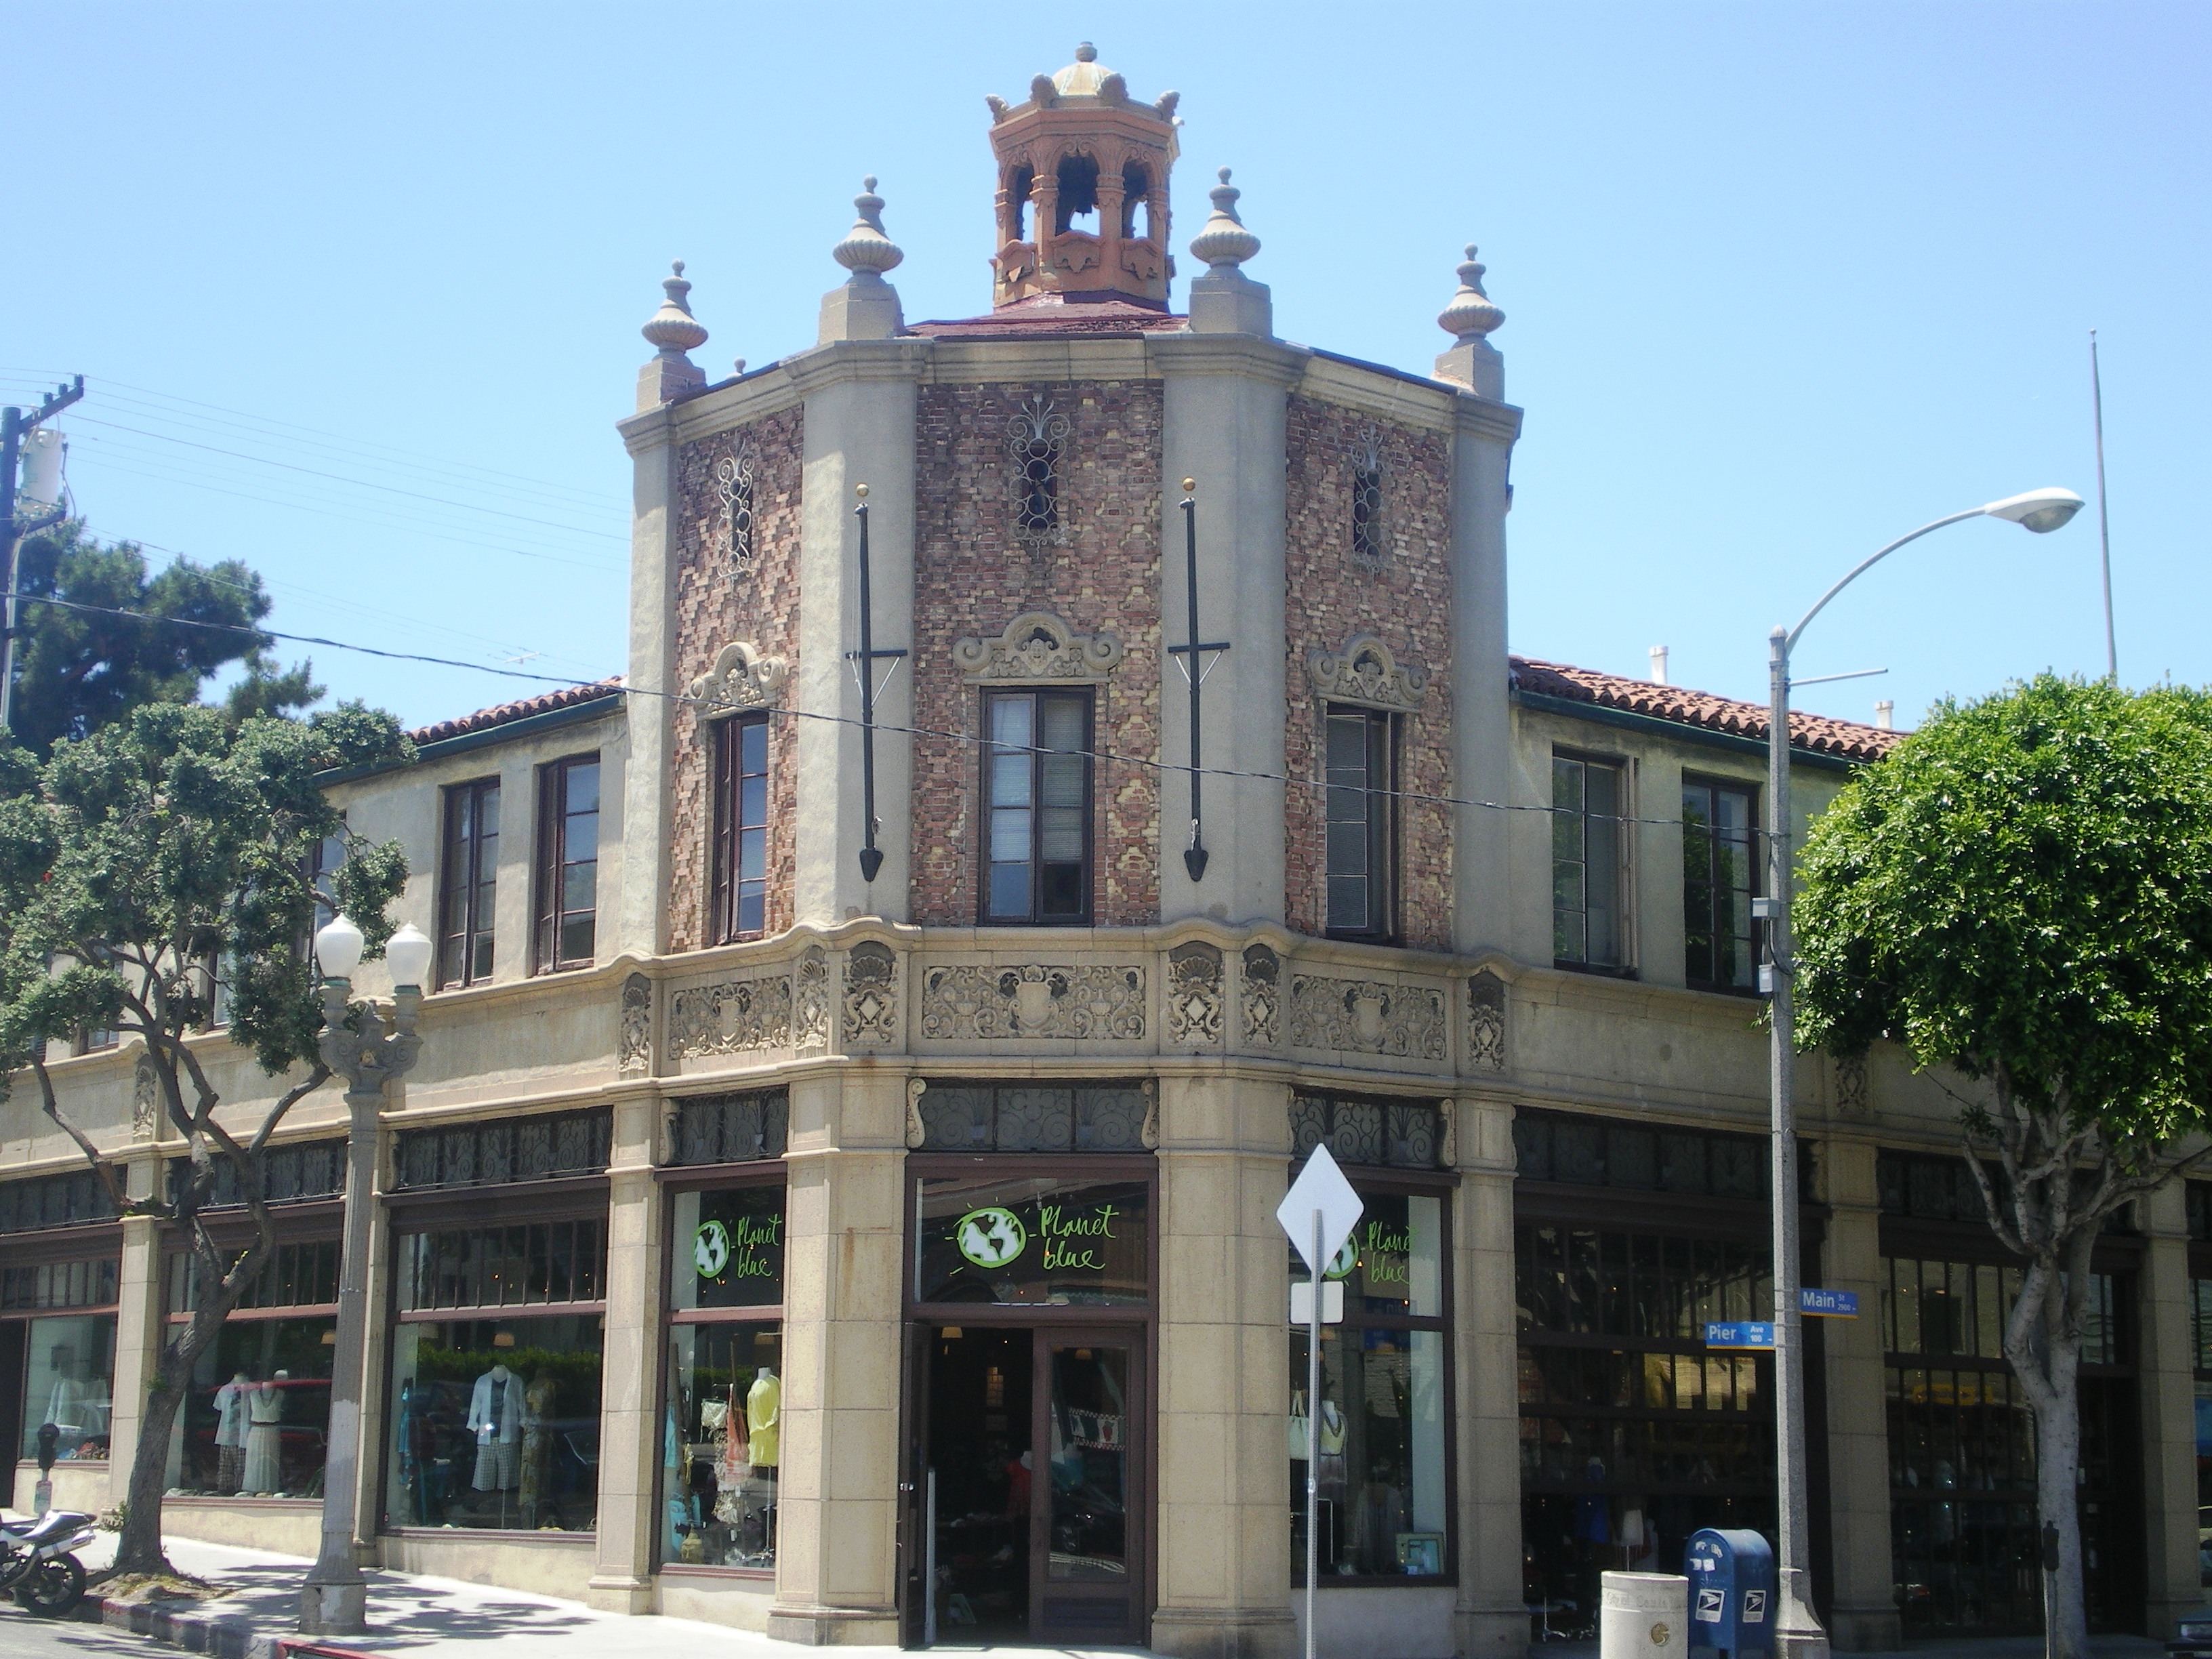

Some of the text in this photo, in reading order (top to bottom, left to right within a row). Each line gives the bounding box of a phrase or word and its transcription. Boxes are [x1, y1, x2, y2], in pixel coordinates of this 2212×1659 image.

[737, 1213, 782, 1247] Planet
[1040, 1204, 1120, 1239] Planet
[737, 1247, 773, 1279] blue
[1042, 1237, 1106, 1270] blue
[1370, 1251, 1412, 1286] blue
[1803, 1291, 1835, 1308] Main
[1708, 1324, 1764, 1340] Pier Ave
[1750, 1334, 1762, 1343] 100
